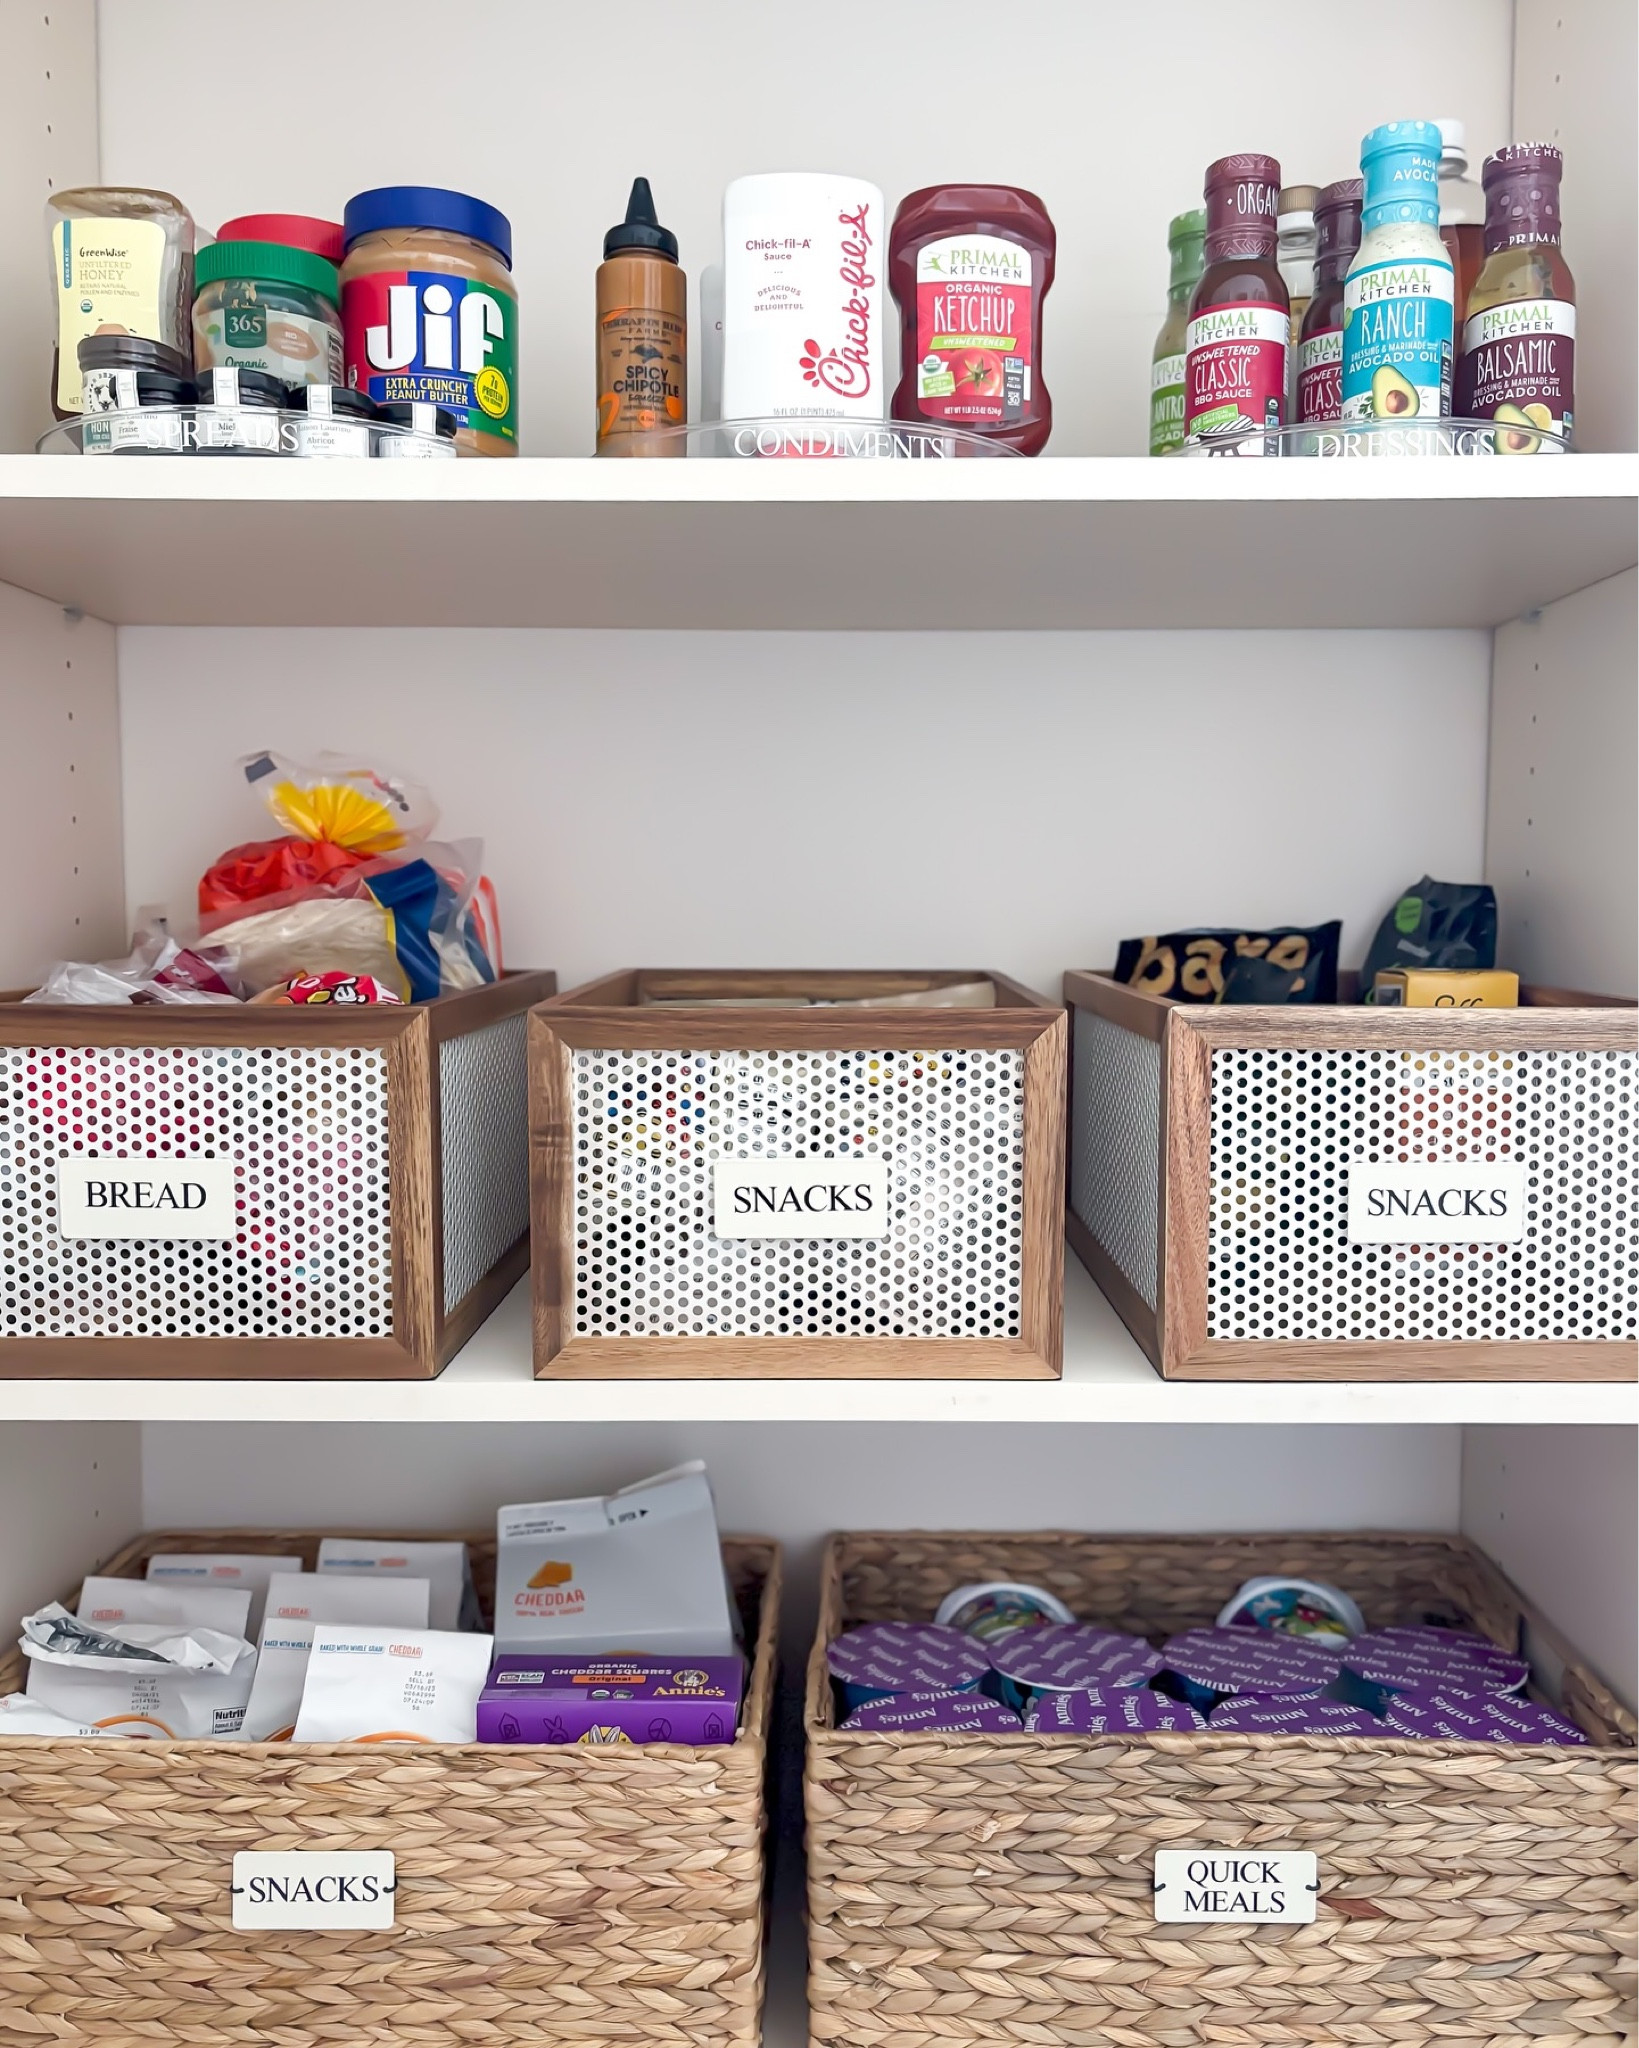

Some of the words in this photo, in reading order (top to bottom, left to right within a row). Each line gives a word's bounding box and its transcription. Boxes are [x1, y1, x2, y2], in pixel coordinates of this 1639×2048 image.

[80, 246, 126, 258] GreenWise
[746, 238, 811, 250] Chick-fil-A
[79, 261, 132, 269] UNFILTERED
[950, 250, 1022, 268] PRIMAL
[80, 270, 124, 280] HONEY
[950, 266, 1022, 278] KITCHEN
[1361, 268, 1430, 292] PRIMAL
[758, 285, 802, 297] DELICIOUS
[946, 284, 1002, 295] ORGANIC
[1360, 284, 1431, 304] KITCHEN
[754, 304, 804, 312] DELIGHTFUL
[934, 296, 1015, 334] KETCHUP
[1482, 305, 1552, 331] PRIMAL
[229, 314, 262, 334] 365
[365, 284, 505, 374] Jif
[1195, 312, 1258, 336] PRIMAL
[1362, 300, 1426, 346] RANCH
[1482, 322, 1554, 341] KITCHEN
[944, 338, 1005, 346] UNSWEETENED
[1194, 326, 1258, 346] KITCHEN
[1192, 346, 1260, 367] UNSWEETENED
[1302, 350, 1341, 368] KITCH
[1351, 344, 1380, 362] DRESSING
[1381, 344, 1387, 353] &
[1388, 341, 1426, 352] MARINADE
[225, 356, 268, 369] Organic
[1348, 352, 1414, 374] AVOCADO
[1420, 352, 1438, 364] OIL
[1477, 340, 1556, 386] BALSAMIC
[626, 366, 668, 382] SPICY
[1195, 358, 1251, 395] CLASSIC
[385, 378, 416, 390] EXTRA
[419, 378, 468, 394] CRUNCHY
[482, 386, 504, 400] PROTEIN
[614, 380, 679, 398] CHIPOTLE
[1473, 382, 1502, 398] DRESSING
[1504, 380, 1508, 388] &
[1511, 376, 1548, 388] MARINADE
[386, 390, 426, 400] PEANUT
[429, 390, 468, 405] BUTTER
[1194, 394, 1213, 406] BBQ
[1216, 388, 1253, 400] SAUCE
[1472, 386, 1537, 412] AVOCADO
[1542, 386, 1562, 397] OIL
[944, 406, 953, 414] NET
[1154, 395, 1184, 422] ANTRO
[91, 422, 109, 433] HON
[147, 419, 299, 453] SPREADS
[218, 423, 235, 431] Miel
[307, 437, 335, 445] Abricot
[734, 428, 944, 459] CONDIMENTS
[1316, 428, 1496, 457] DRESSINGS
[84, 1180, 208, 1209] BREAD
[733, 1183, 873, 1214] SNACKS
[1367, 1188, 1508, 1218] SNACKS
[514, 1589, 586, 1606] CHEDDAR
[388, 1644, 421, 1656] CHEDDAR
[653, 1686, 726, 1697] Annie's
[878, 1706, 937, 1724] Annie's
[953, 1700, 1000, 1714] nnie's
[1051, 1694, 1075, 1727] Annie's
[1120, 1694, 1144, 1728] Annie's
[1250, 1708, 1311, 1723] Annie's
[1429, 1696, 1482, 1726] Annie's
[1304, 1720, 1362, 1736] Annie's
[1482, 1704, 1536, 1734] Annie's
[1538, 1712, 1589, 1744] Annie's
[1187, 1860, 1283, 1888] QUICK
[249, 1876, 378, 1903] SNACKS
[1183, 1890, 1286, 1914] MEALS
